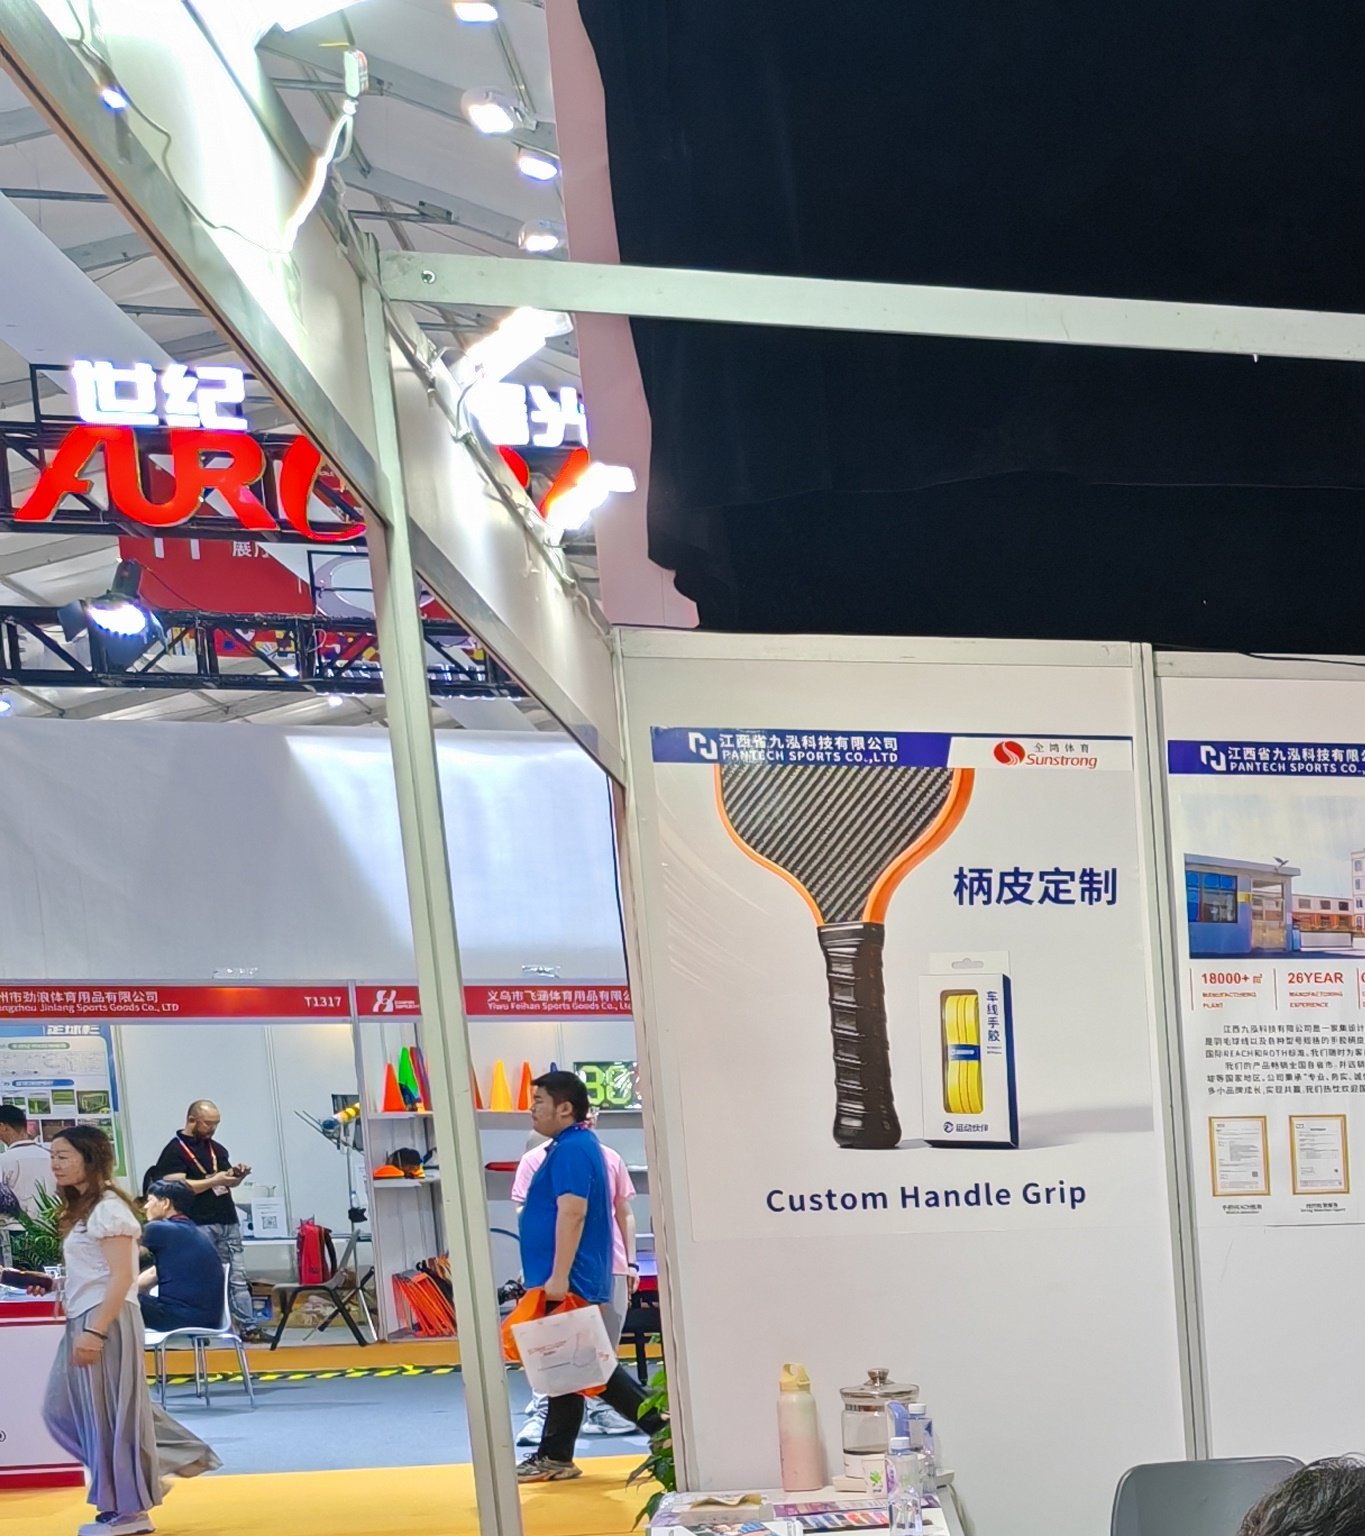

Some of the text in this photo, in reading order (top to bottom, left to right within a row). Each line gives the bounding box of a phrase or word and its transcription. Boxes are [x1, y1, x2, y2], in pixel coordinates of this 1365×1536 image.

[72, 358, 250, 432] 世纪
[719, 734, 898, 752] 江西省九泓科技有限公司
[723, 751, 785, 762] PANTECH
[790, 751, 842, 763] SPORTS
[1025, 753, 1098, 769] Sunstrong
[1230, 762, 1286, 772] PANTECH
[1290, 763, 1337, 773] SPORTS
[954, 866, 1118, 907] 柄皮定制
[1287, 972, 1344, 984] 26YEAR
[77, 1003, 108, 1013] Sports
[110, 1003, 140, 1012] Goods
[162, 1003, 179, 1012] LTD
[304, 996, 341, 1008] T1317
[542, 1002, 570, 1011] Sports
[572, 1002, 600, 1010] Goods
[766, 1180, 1087, 1214] Custom Handle Grip
